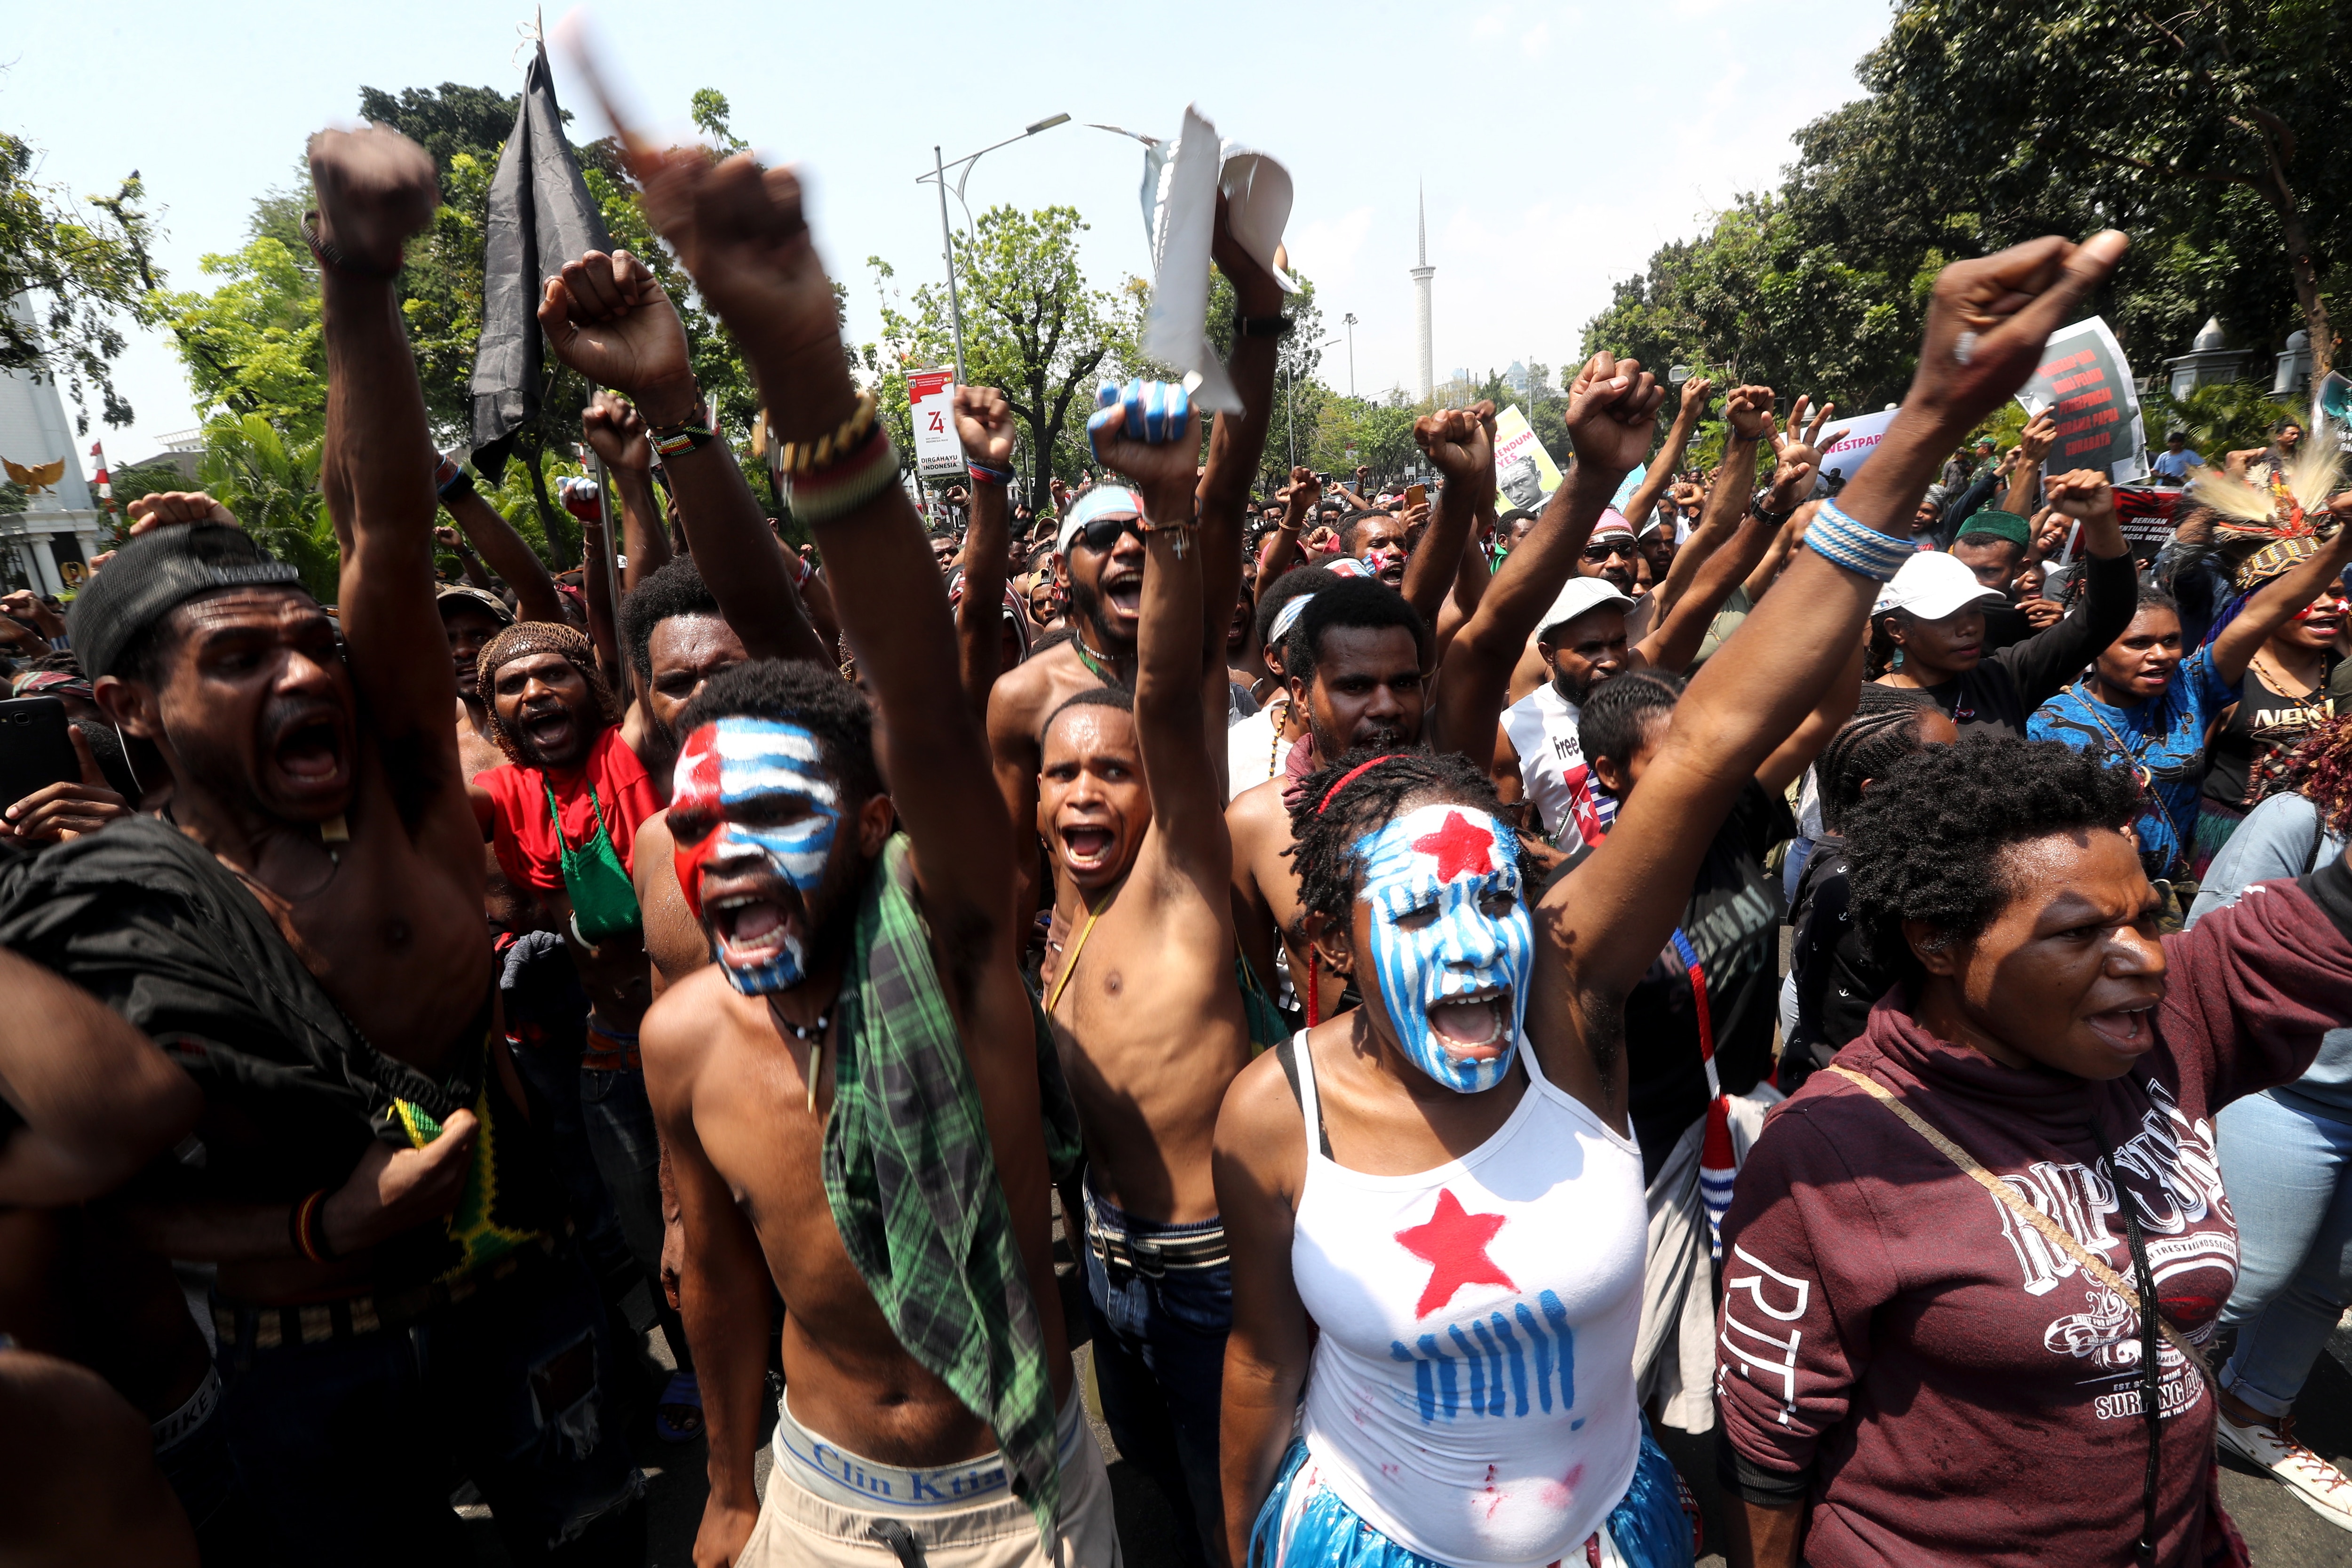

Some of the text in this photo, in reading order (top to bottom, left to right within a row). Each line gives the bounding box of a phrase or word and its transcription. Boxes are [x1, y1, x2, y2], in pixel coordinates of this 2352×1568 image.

[928, 411, 944, 433] 74
[2092, 407, 2120, 427] PAPUA
[2065, 431, 2111, 456] SURABAYA
[921, 455, 958, 463] DIRGAHAYU
[1496, 453, 1518, 468] YES
[1552, 736, 1579, 760] Free
[2093, 1318, 2106, 1326] FOR
[2114, 1382, 2131, 1391] EST.
[2163, 1368, 2182, 1381] NINE
[154, 1391, 208, 1445] NIKE
[2172, 1405, 2185, 1416] THE
[813, 1443, 892, 1496] Clin
